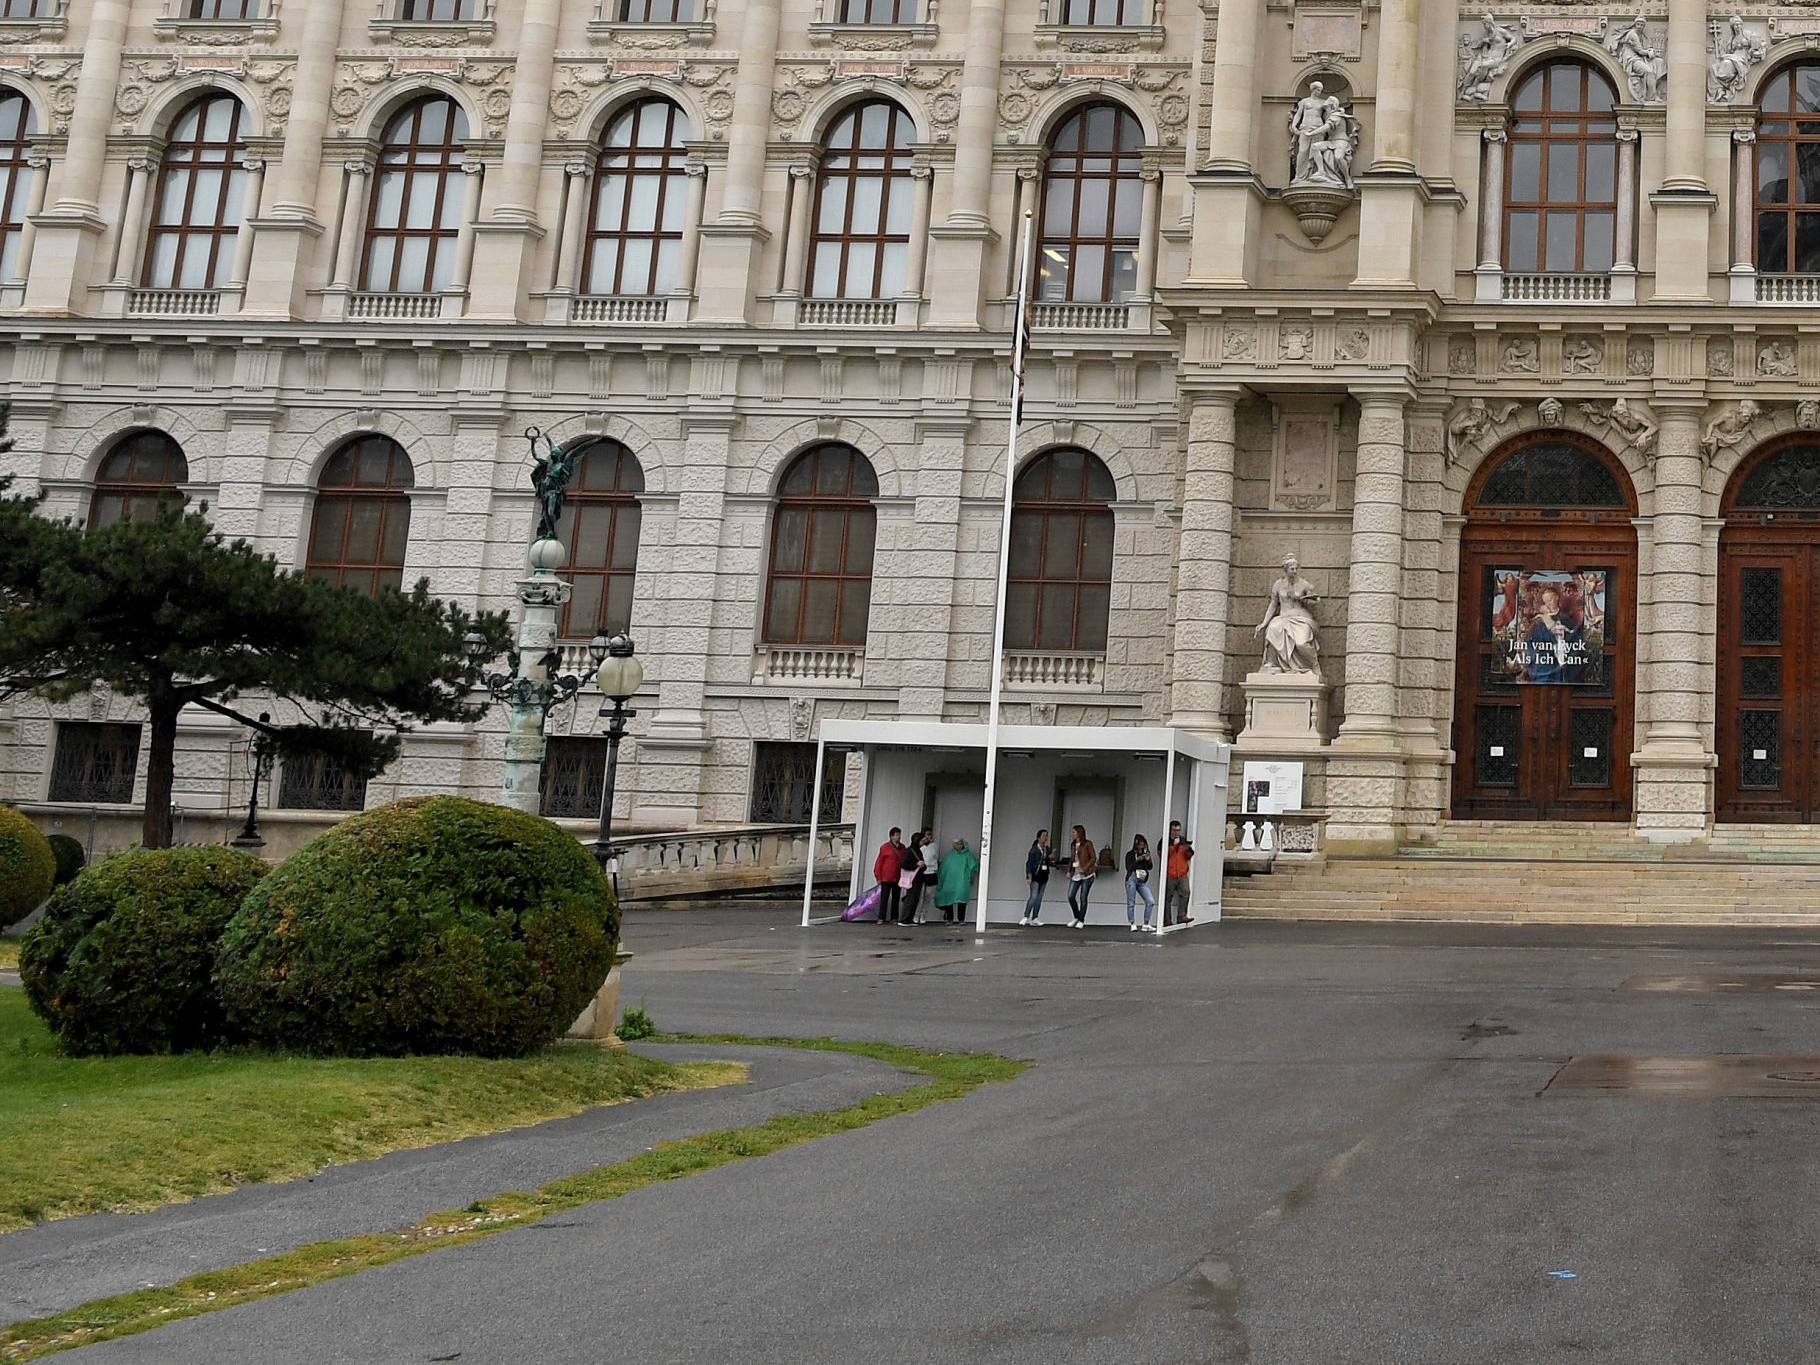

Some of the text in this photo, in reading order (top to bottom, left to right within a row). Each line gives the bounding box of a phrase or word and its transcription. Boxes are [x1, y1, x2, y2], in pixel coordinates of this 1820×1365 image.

[1508, 639, 1586, 653] Jan van Eyck
[1535, 652, 1554, 665] Ich
